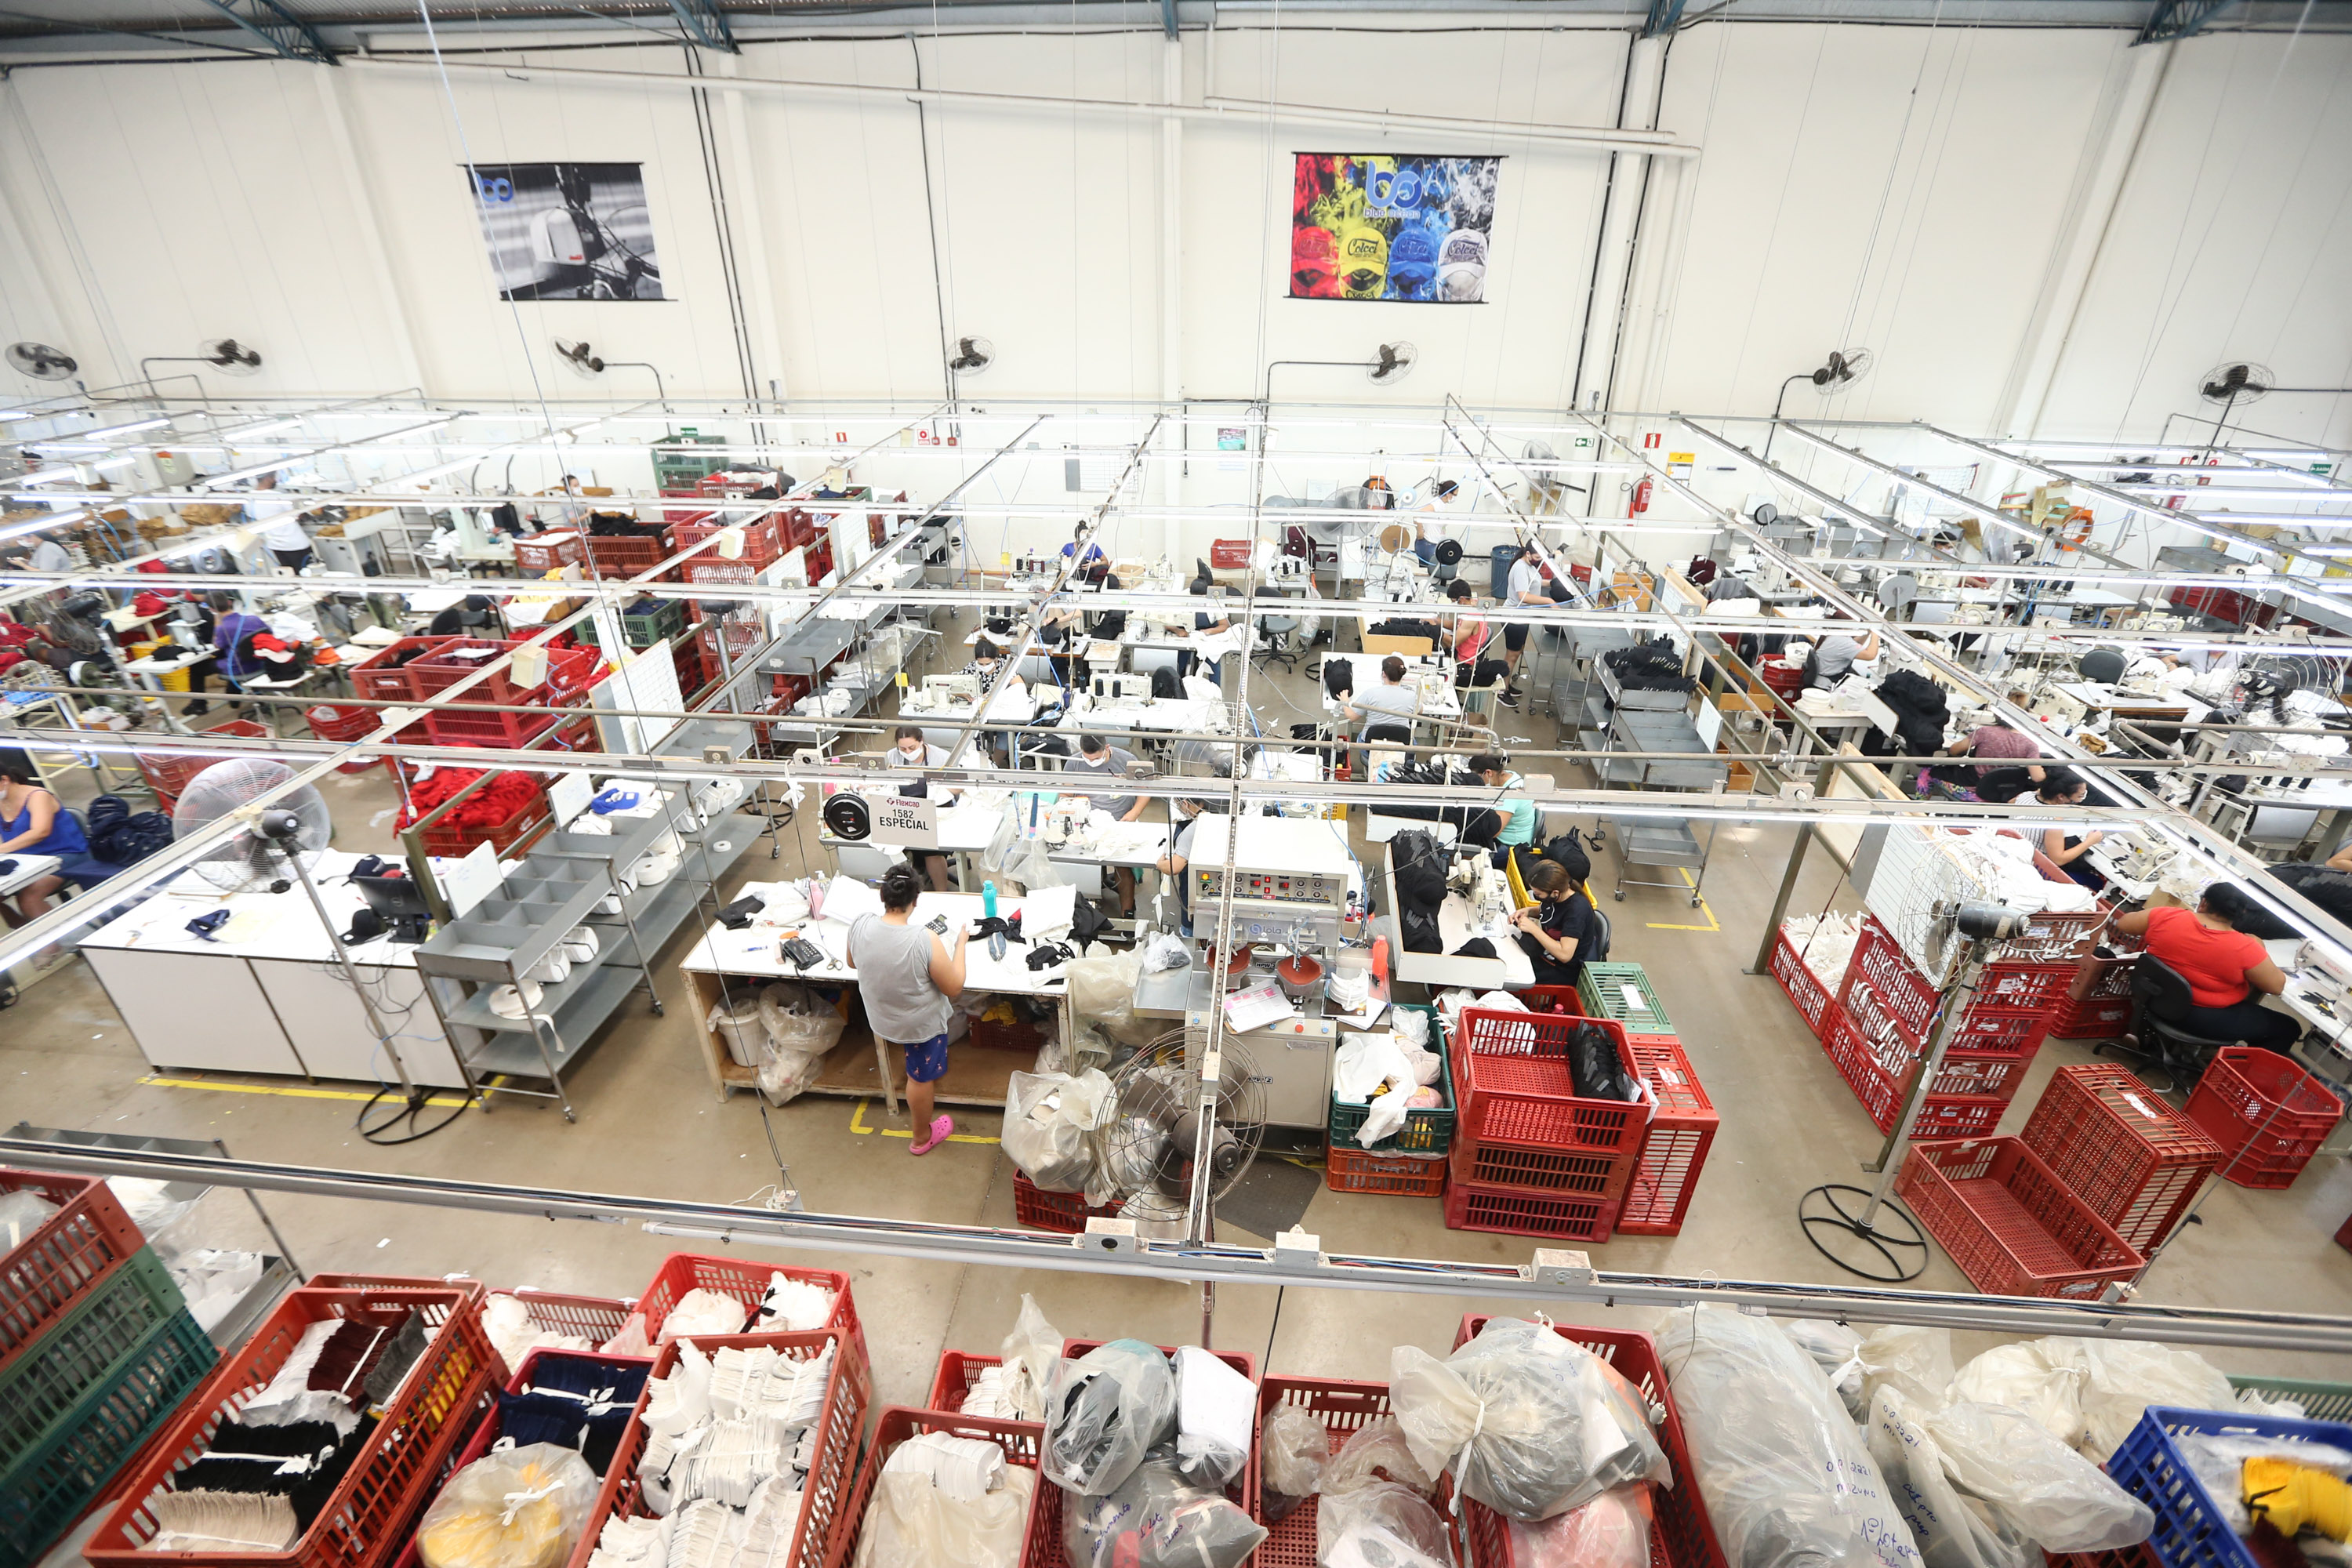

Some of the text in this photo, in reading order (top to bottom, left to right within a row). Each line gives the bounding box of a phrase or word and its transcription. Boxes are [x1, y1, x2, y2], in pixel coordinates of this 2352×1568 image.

[1364, 208, 1421, 220] blue ocean
[895, 799, 920, 808] Flexcap
[892, 808, 913, 819] 1582
[880, 816, 929, 830] ESPECIAL
[1850, 1462, 1871, 1476] 2221
